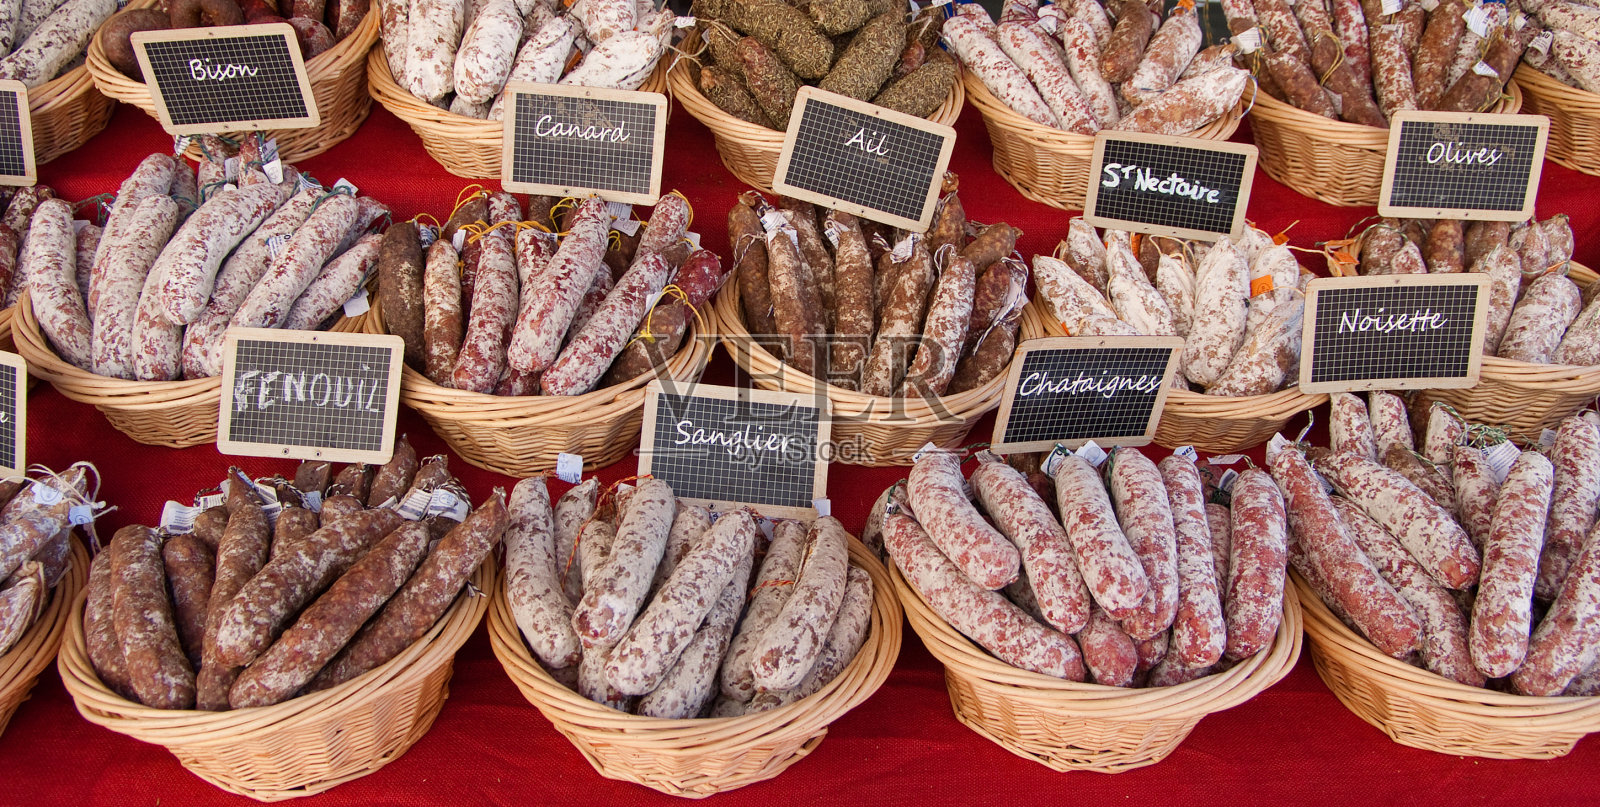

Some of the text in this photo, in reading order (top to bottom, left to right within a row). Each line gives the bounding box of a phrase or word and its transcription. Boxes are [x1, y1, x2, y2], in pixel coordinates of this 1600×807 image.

[189, 58, 258, 81] Bison
[535, 114, 631, 143] Canard
[844, 127, 890, 157] Ail
[1426, 141, 1503, 167] Olives
[1135, 167, 1221, 204] Nectaire
[1338, 307, 1449, 334] Noisette
[1019, 369, 1163, 401] Chataignes
[675, 420, 795, 456] Sanglier
